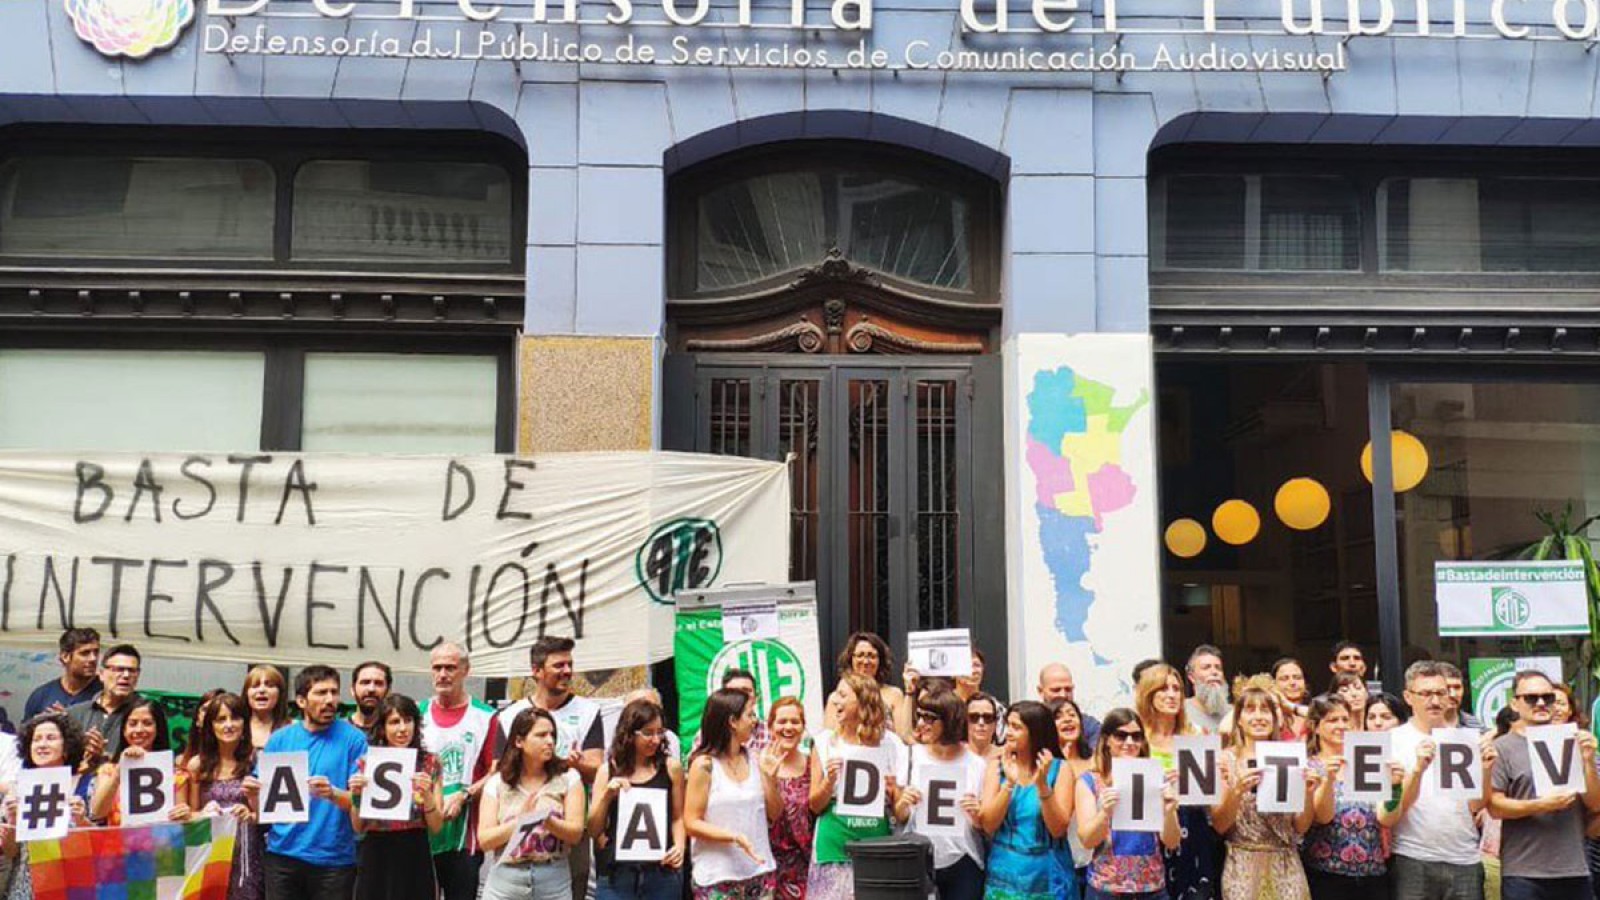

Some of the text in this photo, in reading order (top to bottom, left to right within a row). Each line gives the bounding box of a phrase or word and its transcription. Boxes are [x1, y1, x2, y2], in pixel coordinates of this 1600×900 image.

[203, 24, 400, 55] Defensoría
[478, 31, 602, 61] Público
[615, 34, 655, 62] de
[671, 36, 829, 67] Servicios
[847, 39, 888, 67] de
[905, 41, 1136, 70] Comunicación
[1153, 42, 1346, 70] Audiovisual
[73, 455, 537, 526] BASTA DE
[646, 525, 713, 597] ATE
[1, 542, 589, 651] INTERVENCIÓN
[371, 762, 403, 809] S
[843, 759, 880, 806] D
[1178, 749, 1216, 796] N
[1264, 756, 1300, 803] T
[1354, 745, 1382, 792] E
[1439, 743, 1475, 789] R
[1533, 738, 1576, 786] V
[22, 783, 65, 829] #
[128, 767, 165, 815] B
[263, 766, 305, 813] A
[927, 779, 957, 826] E
[1131, 773, 1145, 821] I
[620, 803, 661, 850] A
